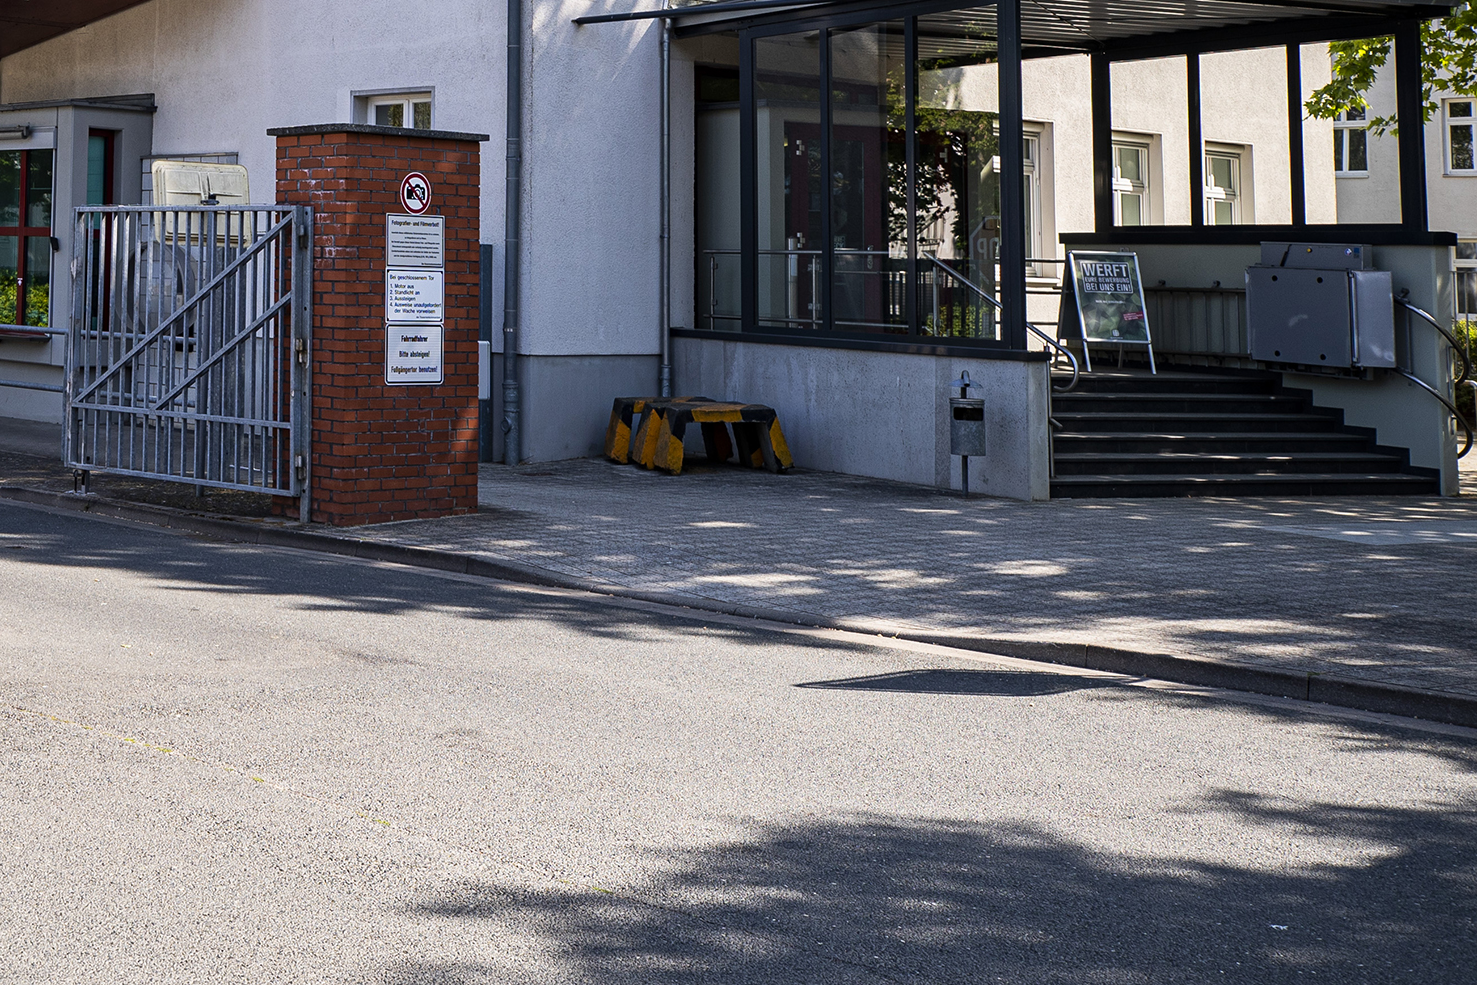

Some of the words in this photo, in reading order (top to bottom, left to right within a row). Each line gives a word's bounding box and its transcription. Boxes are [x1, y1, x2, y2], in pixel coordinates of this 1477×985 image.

[1083, 263, 1127, 277] WERFT
[1085, 283, 1098, 291] BEI
[1099, 283, 1114, 291] UNS
[1116, 284, 1132, 292] EIN!
